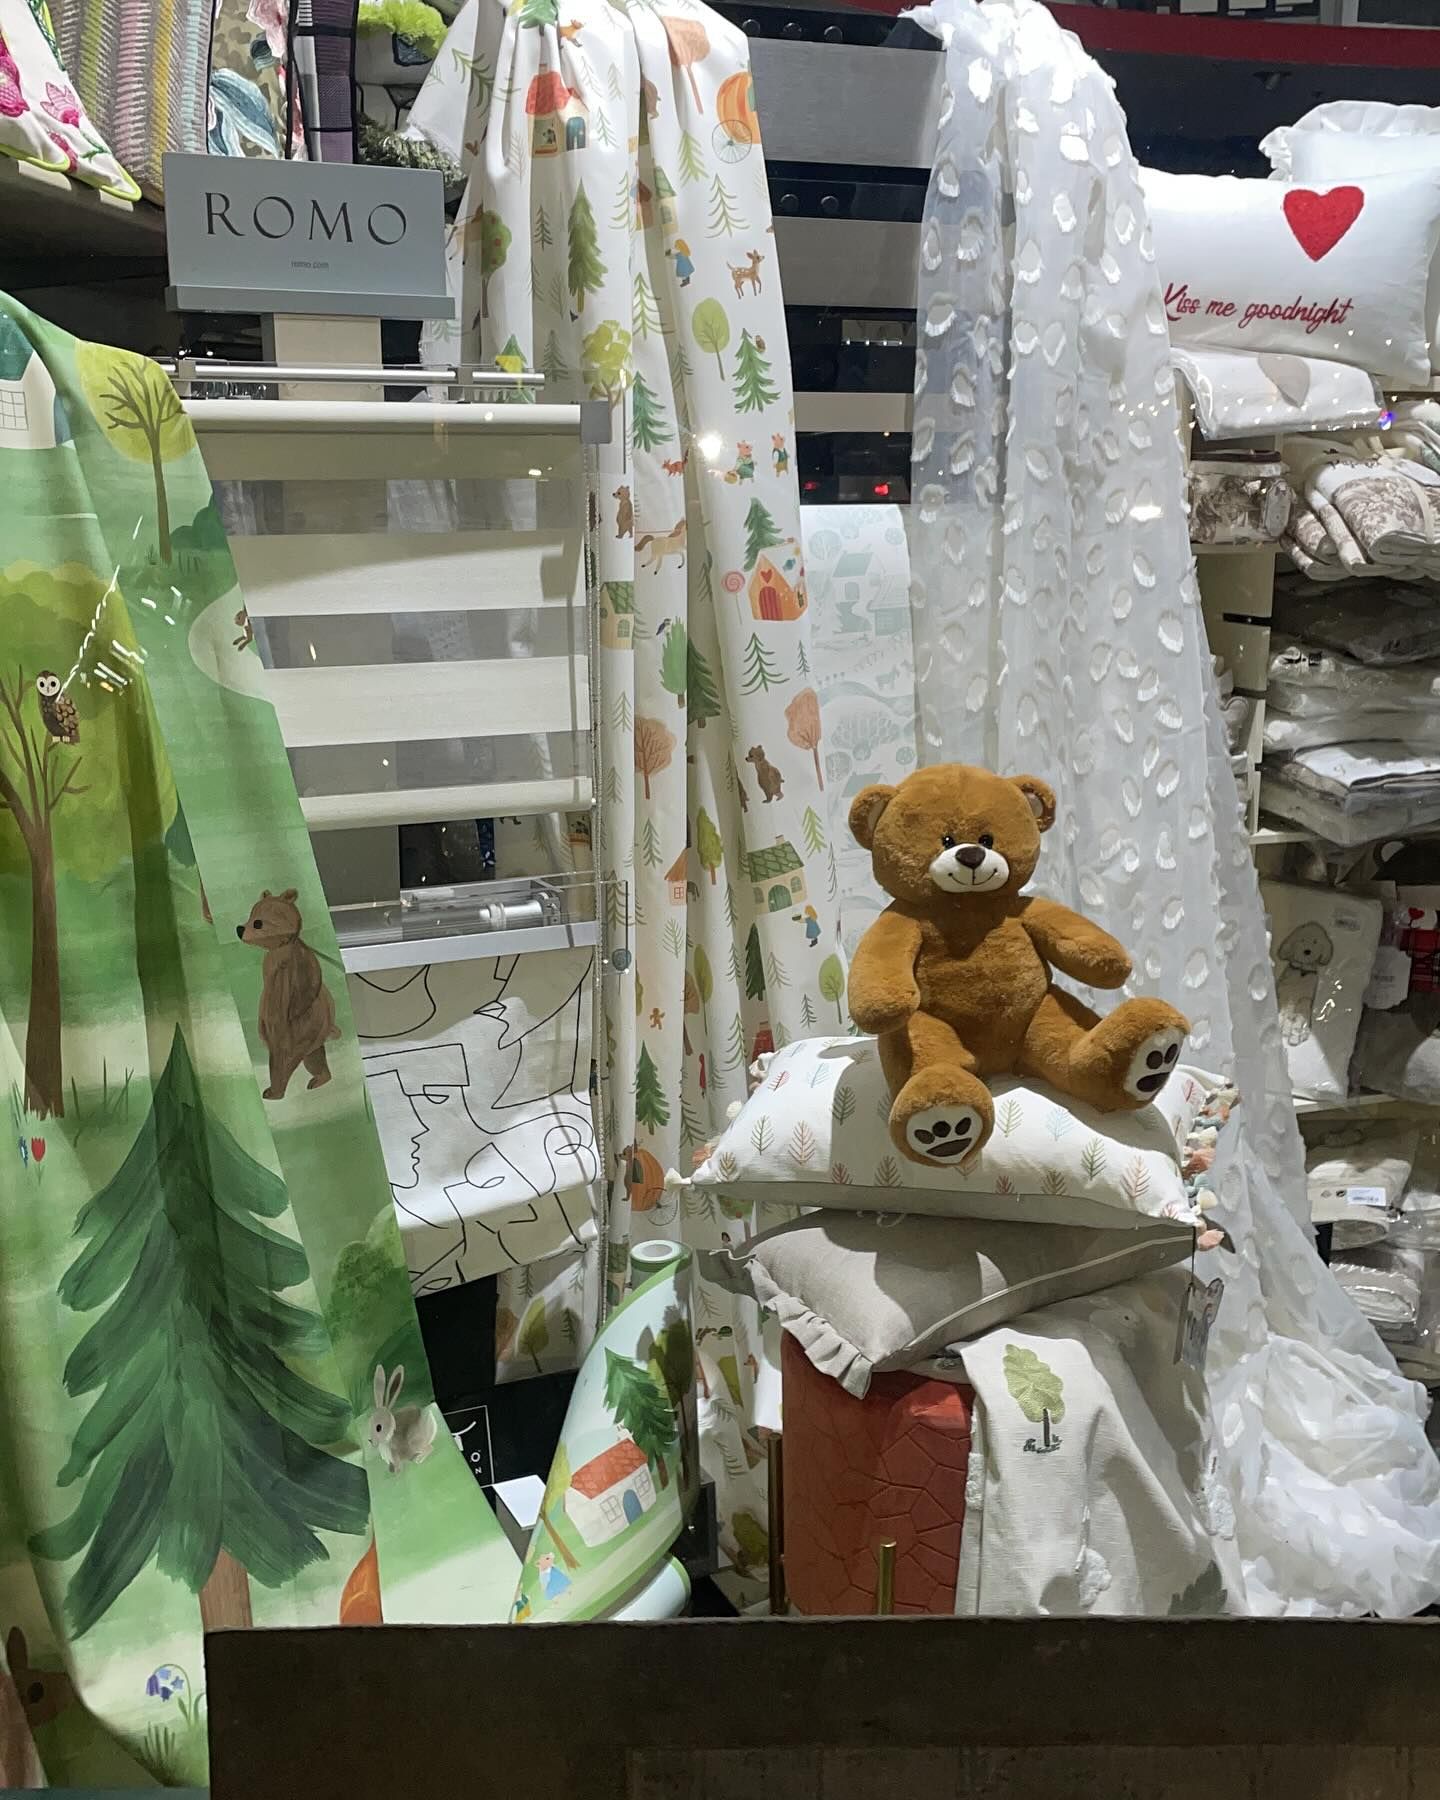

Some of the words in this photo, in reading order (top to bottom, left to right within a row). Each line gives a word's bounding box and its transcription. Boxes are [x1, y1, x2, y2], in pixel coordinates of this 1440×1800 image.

[205, 192, 407, 245] ROMO
[1164, 282, 1201, 321] Kiss
[1205, 299, 1237, 317] me
[1238, 296, 1354, 334] goodnight
